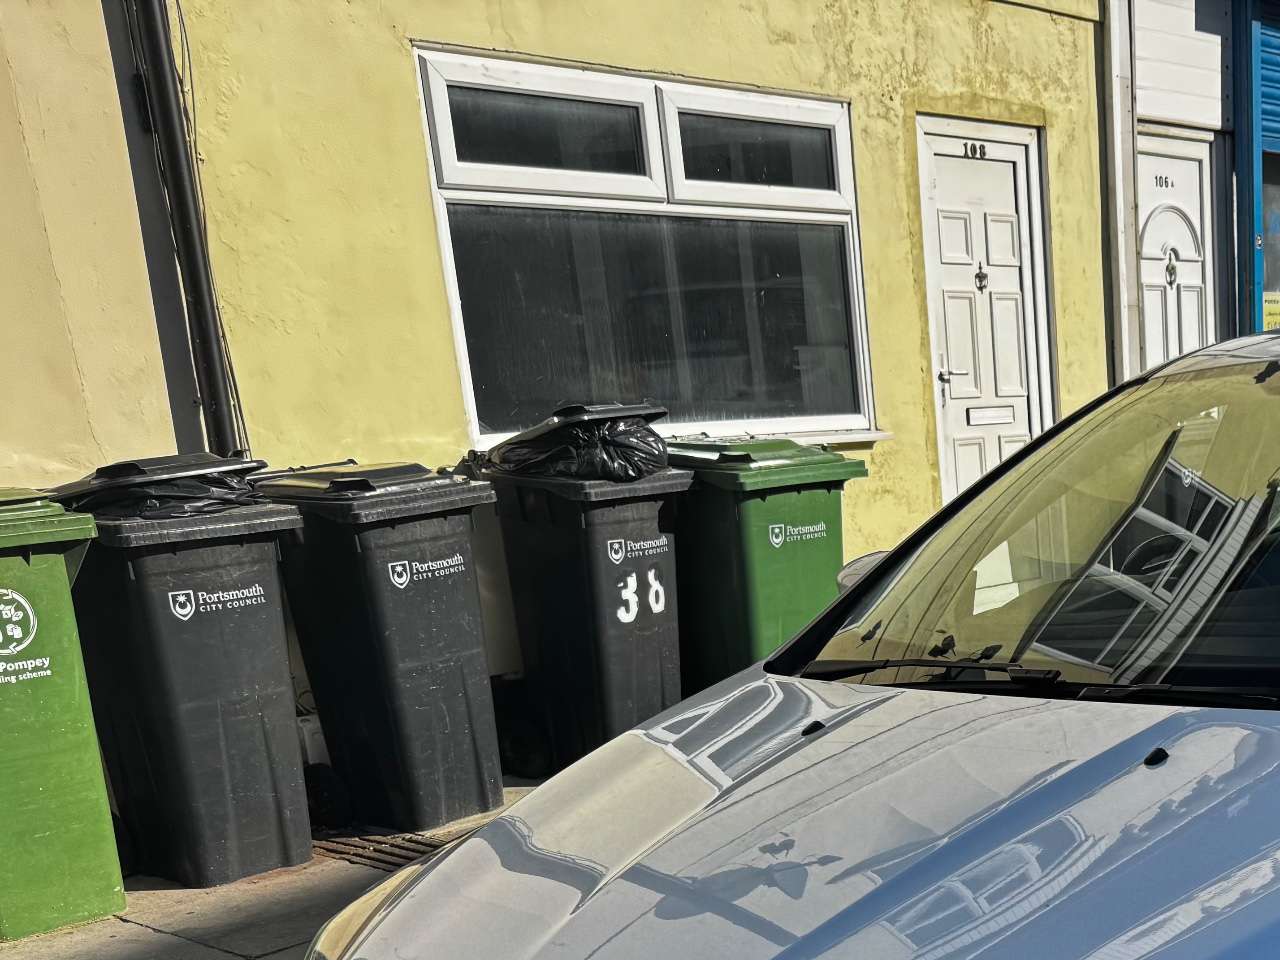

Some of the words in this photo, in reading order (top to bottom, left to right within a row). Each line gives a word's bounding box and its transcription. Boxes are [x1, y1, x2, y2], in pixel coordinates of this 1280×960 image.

[786, 521, 826, 536] Portsmouth
[802, 531, 827, 540] COUNCIL
[627, 535, 668, 551] Portsmouth
[645, 546, 668, 556] COUNCIL
[411, 553, 464, 573] Portsmouth
[413, 572, 432, 581] CITY
[435, 564, 466, 577] COUNCIL
[198, 583, 264, 604] Portsmouth
[200, 603, 223, 612] CITY
[227, 596, 266, 609] COUNCIL
[0, 657, 50, 672] Pompey
[18, 669, 52, 680] scheme
